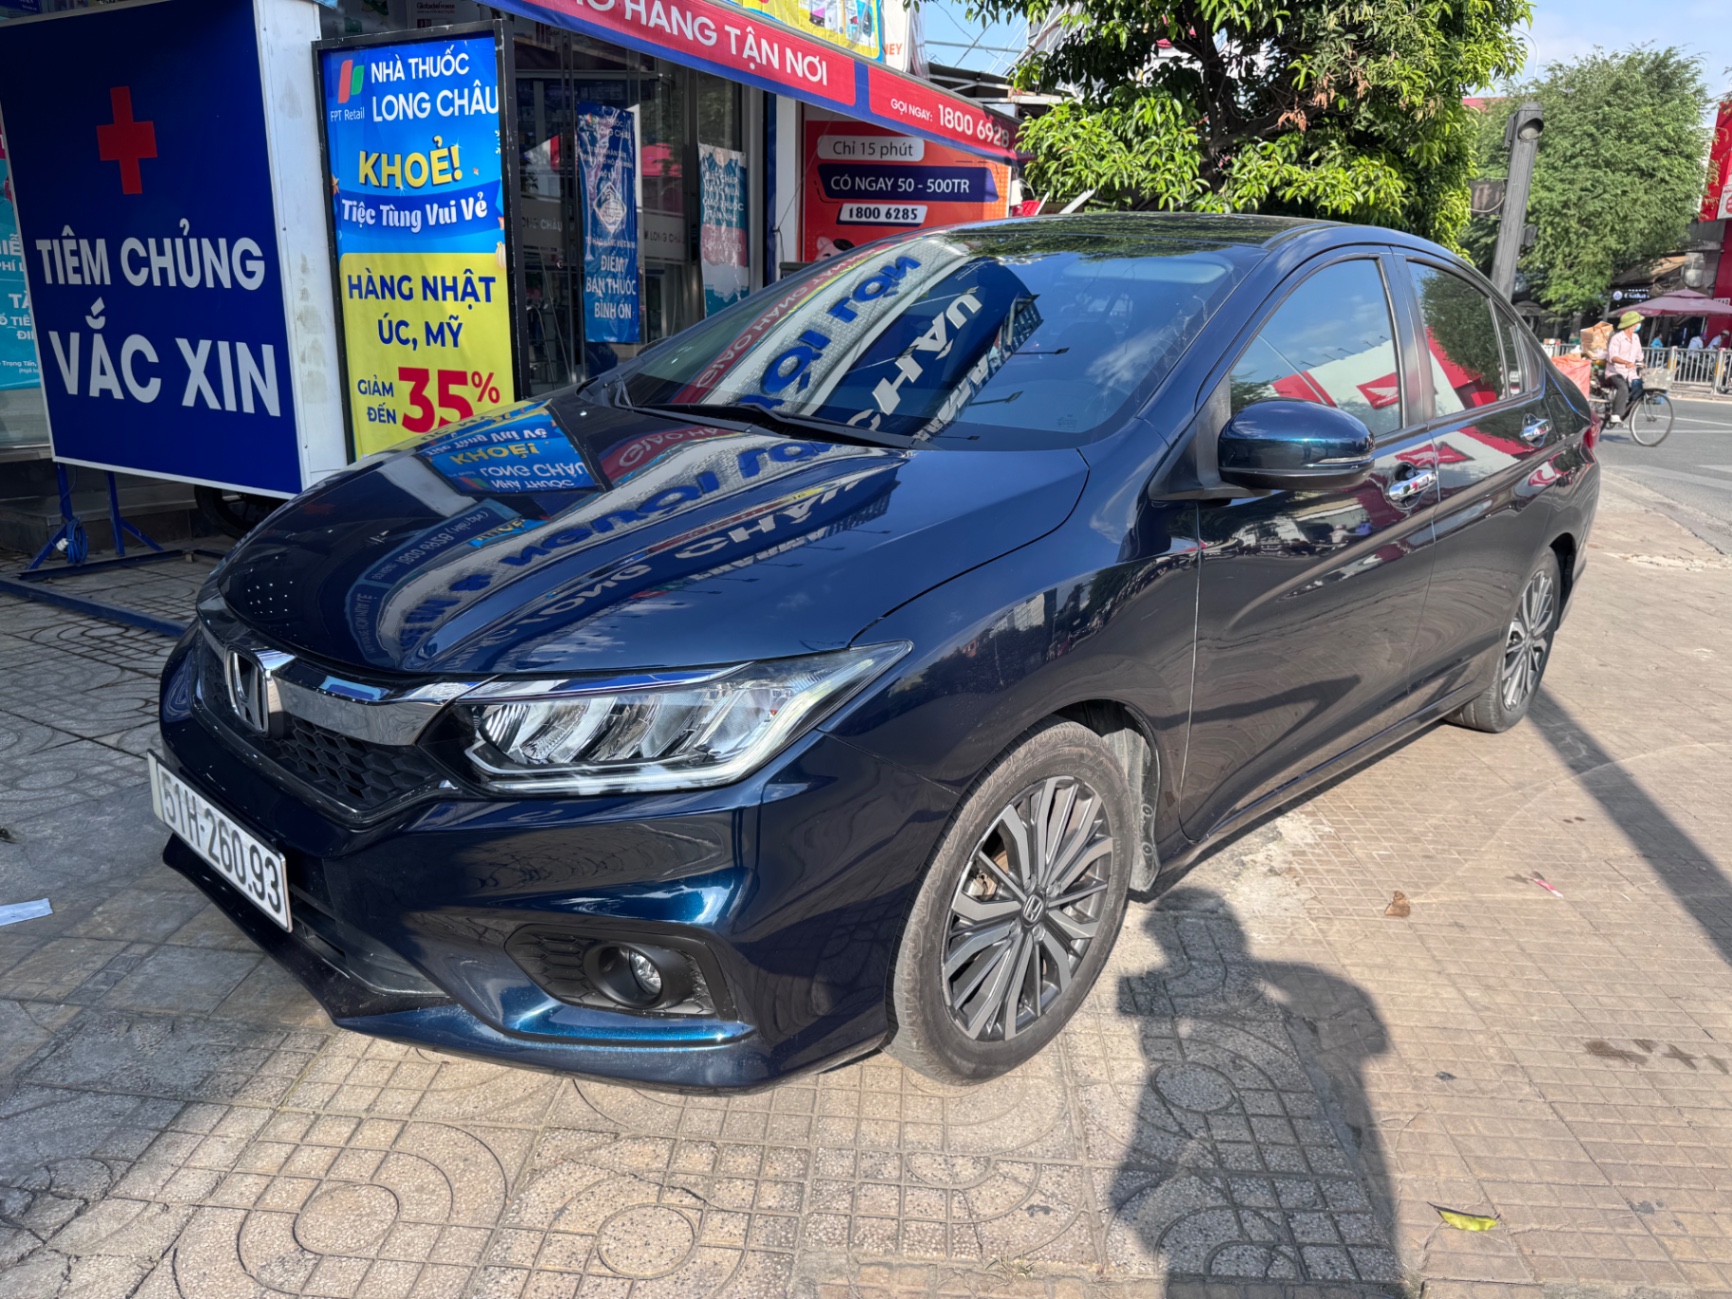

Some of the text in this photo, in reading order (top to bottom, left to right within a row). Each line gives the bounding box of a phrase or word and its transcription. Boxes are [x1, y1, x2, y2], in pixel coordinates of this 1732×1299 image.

[371, 45, 470, 84] NHÀ THUỐC
[724, 25, 780, 70] TẬN
[785, 47, 828, 86] NƠI
[330, 106, 365, 122] FPT Retail
[372, 79, 499, 123] LONG CHÂU
[890, 98, 908, 116] GỌI
[937, 103, 974, 136] 1800
[976, 119, 1010, 148] 6928
[358, 135, 463, 188] KHOẺ!
[832, 140, 914, 159] Chỉ 15 phút
[830, 176, 853, 191] CÓ
[855, 177, 894, 192] NGAY
[897, 177, 915, 193] 50
[926, 178, 970, 193] 500TR
[341, 191, 488, 233] Tiệc Tùng Vui Vẻ
[848, 207, 919, 221] 1800 6285
[35, 219, 266, 291] TIÊM CHỦNG
[347, 267, 496, 310] HÀNG NHẬT
[377, 312, 463, 351] ÚC, MỸ
[48, 296, 282, 417] VẮC XIN
[357, 374, 394, 397] GIẢM
[398, 366, 501, 434] 35%
[366, 402, 397, 424] ĐẾN
